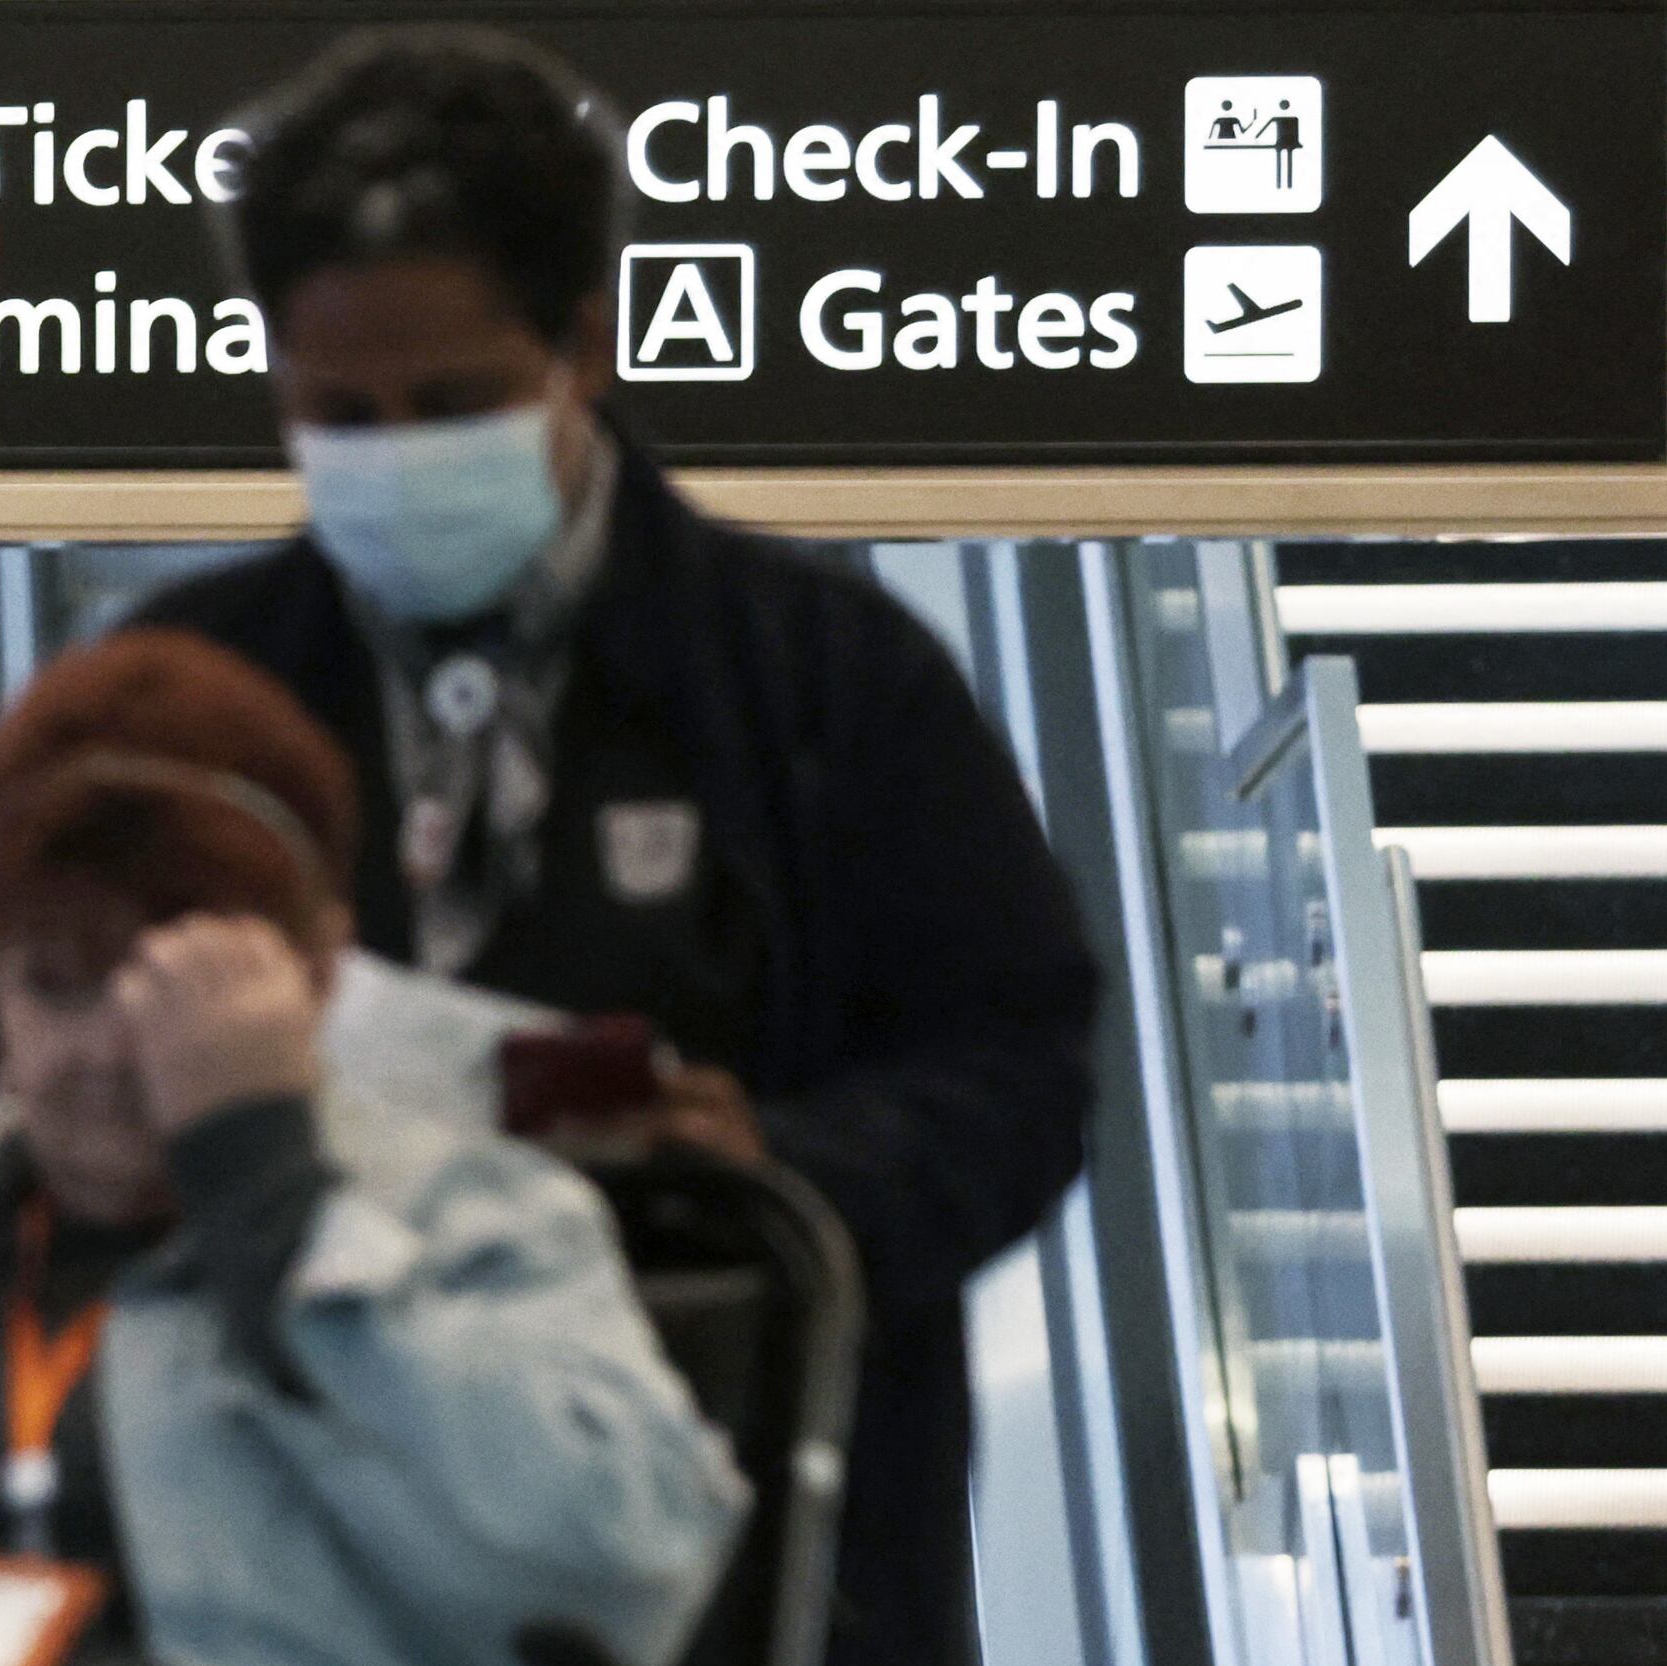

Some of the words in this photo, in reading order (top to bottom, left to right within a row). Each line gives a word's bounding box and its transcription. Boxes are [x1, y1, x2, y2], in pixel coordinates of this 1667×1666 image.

[627, 94, 1139, 203] Check-In
[636, 264, 734, 362] A
[799, 269, 1138, 370] Gates
